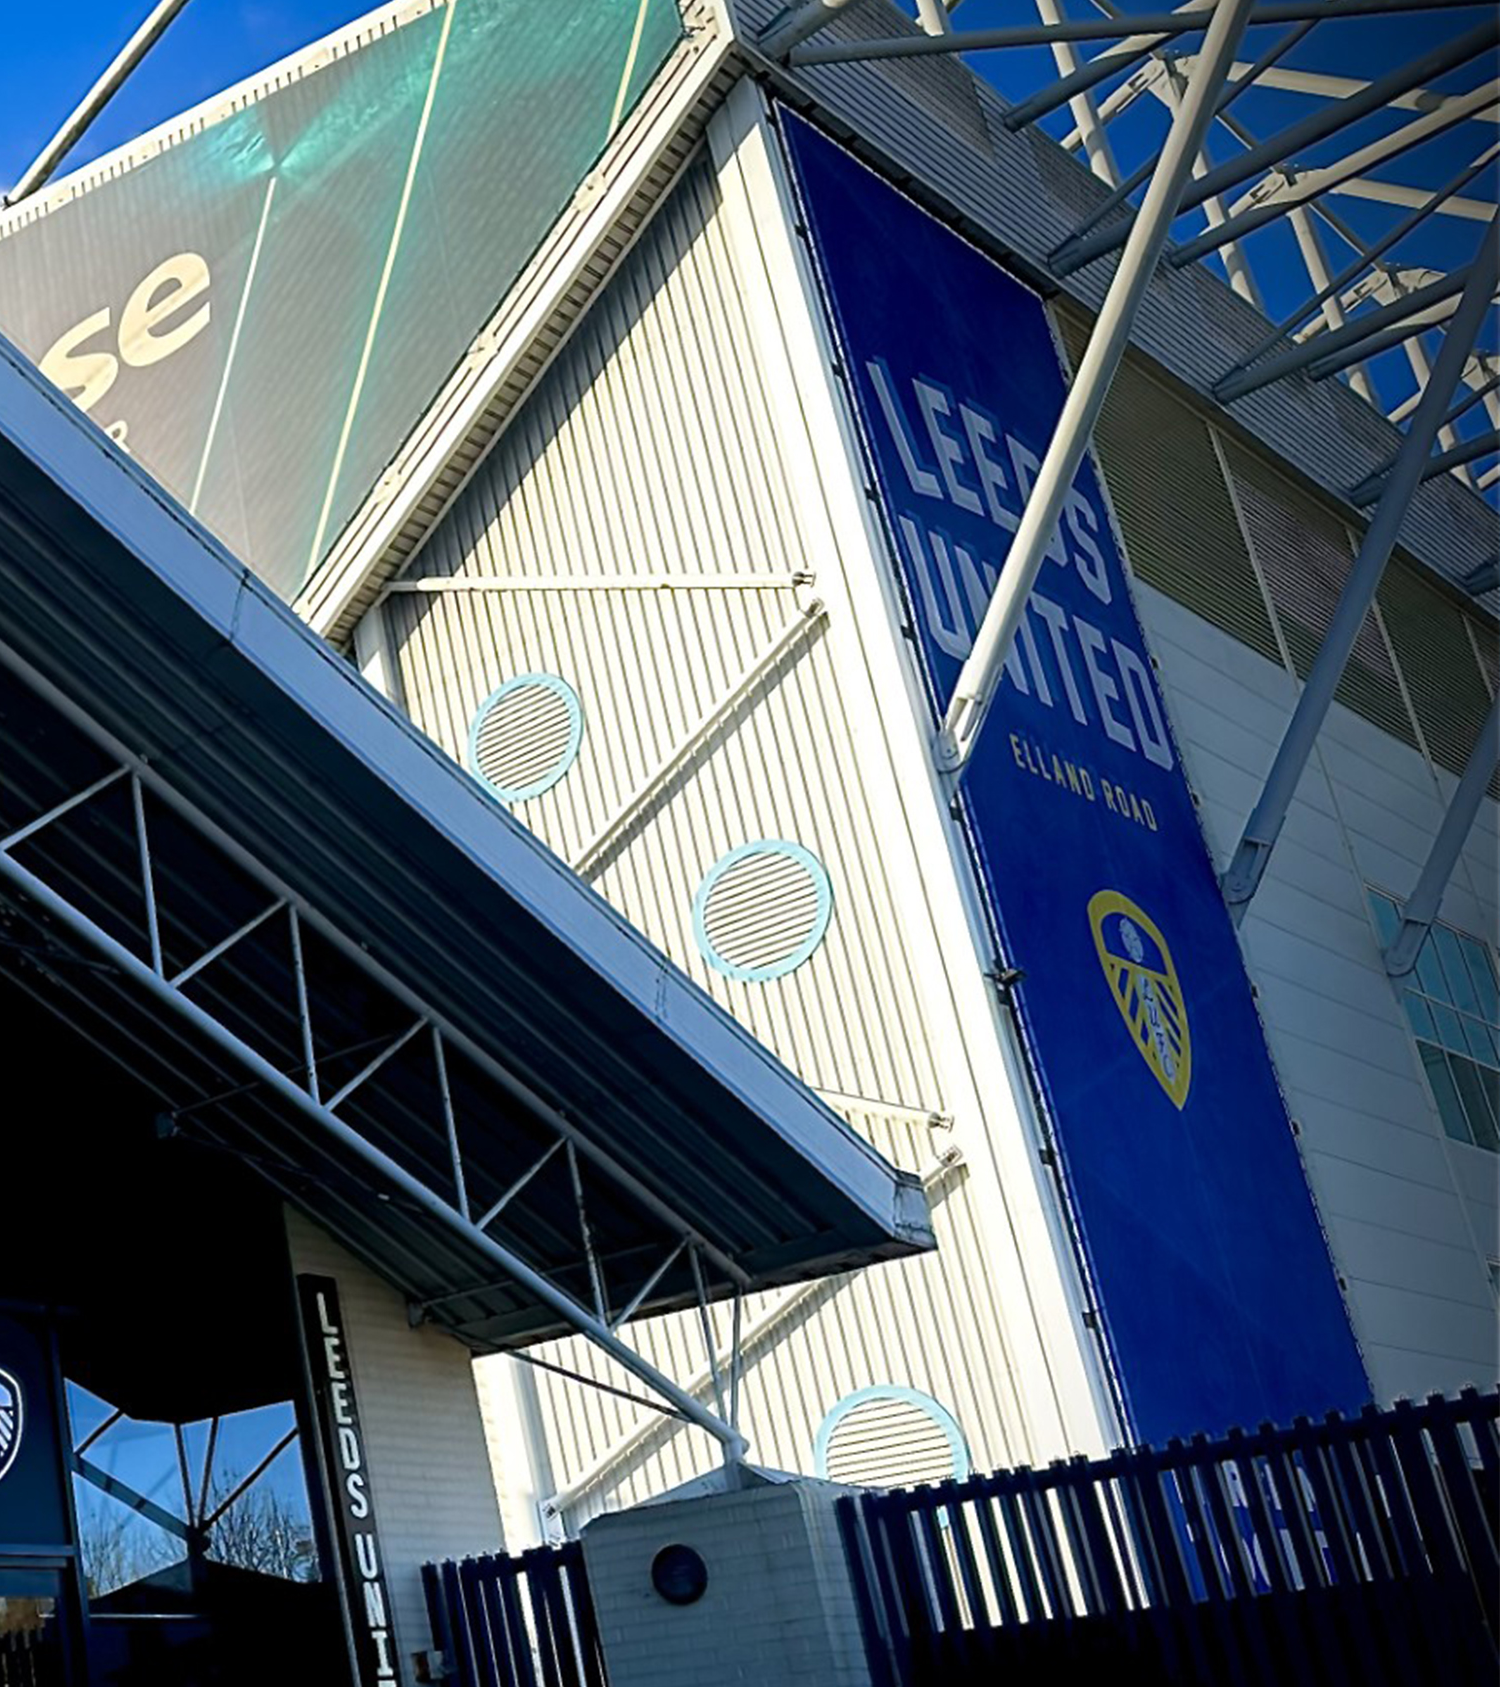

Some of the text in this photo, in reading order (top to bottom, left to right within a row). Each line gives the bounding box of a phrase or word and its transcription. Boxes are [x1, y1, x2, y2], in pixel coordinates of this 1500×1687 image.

[866, 360, 1111, 605] LEEDS
[898, 515, 1173, 771] UNITED
[1009, 733, 1157, 831] ELLAND ROAD
[317, 1292, 398, 1687] LEEDS UNI
